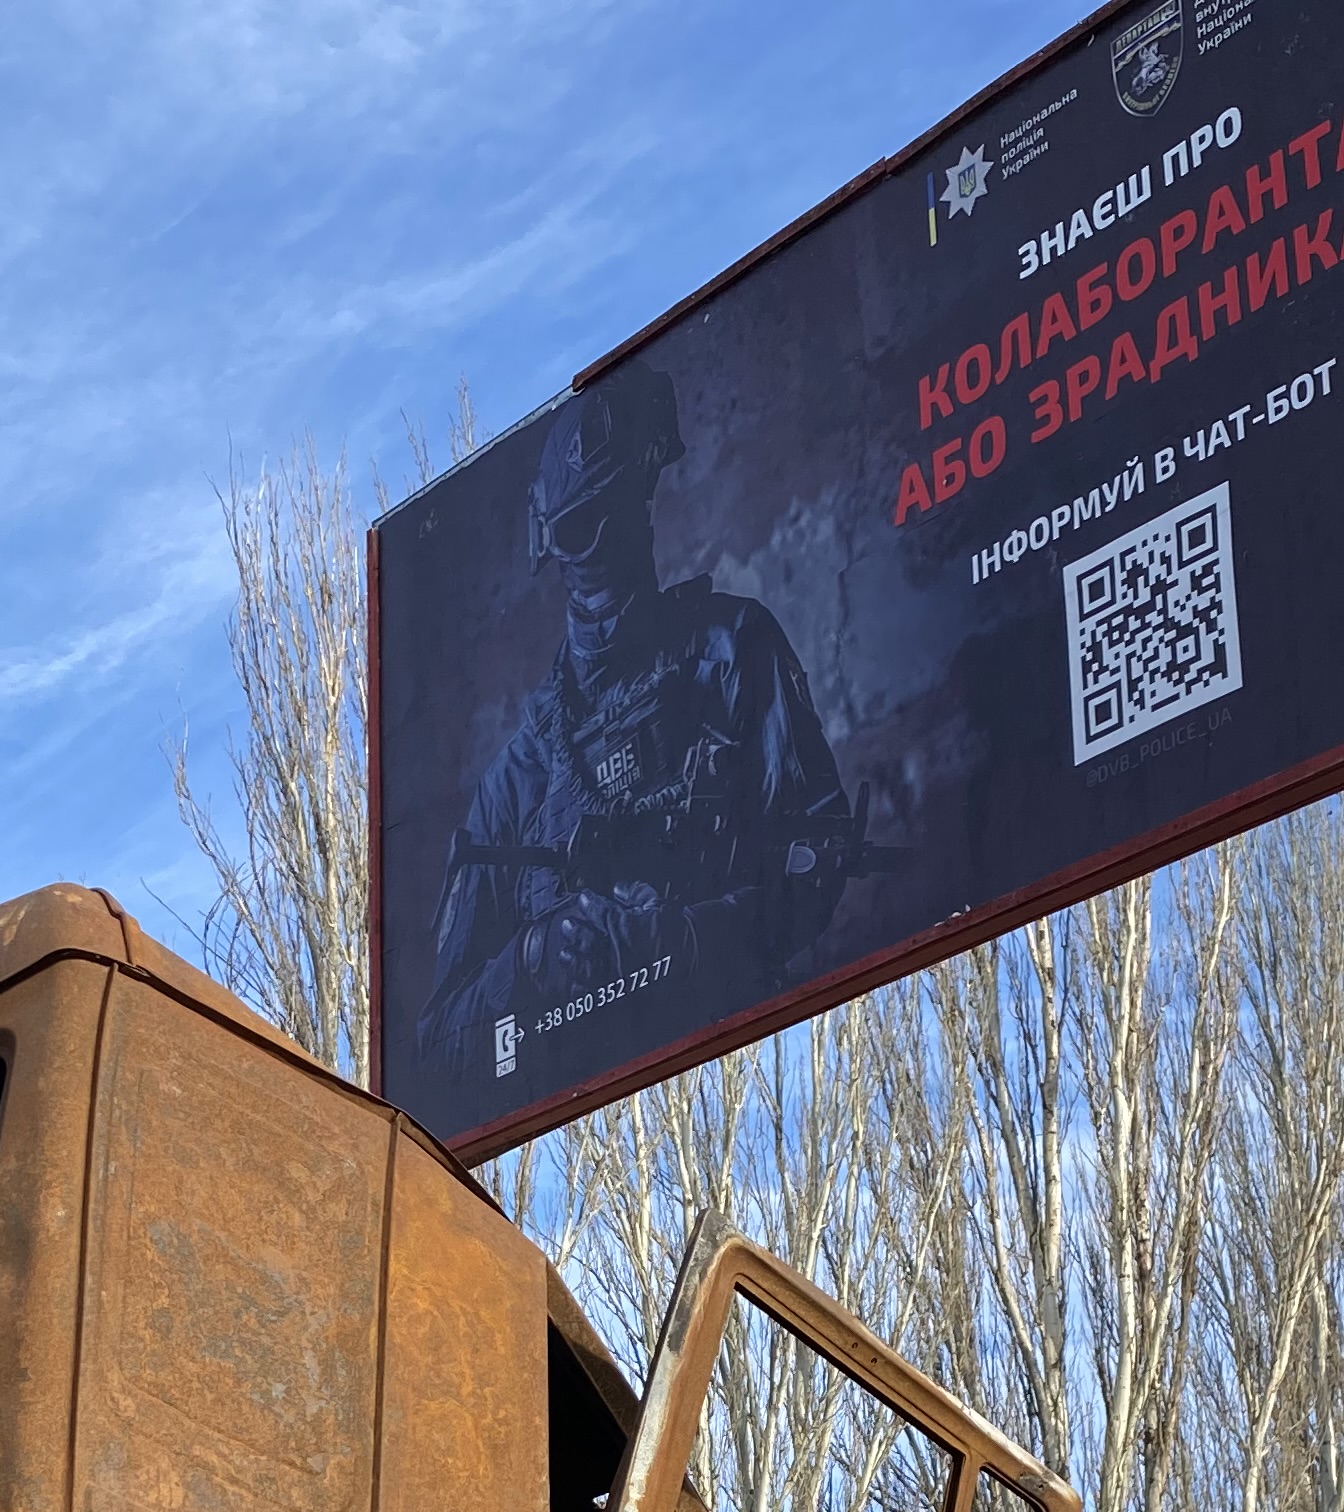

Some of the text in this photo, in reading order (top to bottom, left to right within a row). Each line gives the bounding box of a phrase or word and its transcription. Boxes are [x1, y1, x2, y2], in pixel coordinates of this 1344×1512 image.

[1198, 13, 1252, 55] України
[1000, 88, 1078, 149] Національна
[1001, 127, 1044, 164] поліція
[1002, 141, 1049, 180] України
[1017, 107, 1244, 280] ЗНАЄШ ПРО
[893, 415, 1007, 526] АБО
[971, 358, 1337, 585] ІНФОРМУЙ В ЧАТ-БОТ
[535, 956, 671, 1033] +38 050 352 72 77
